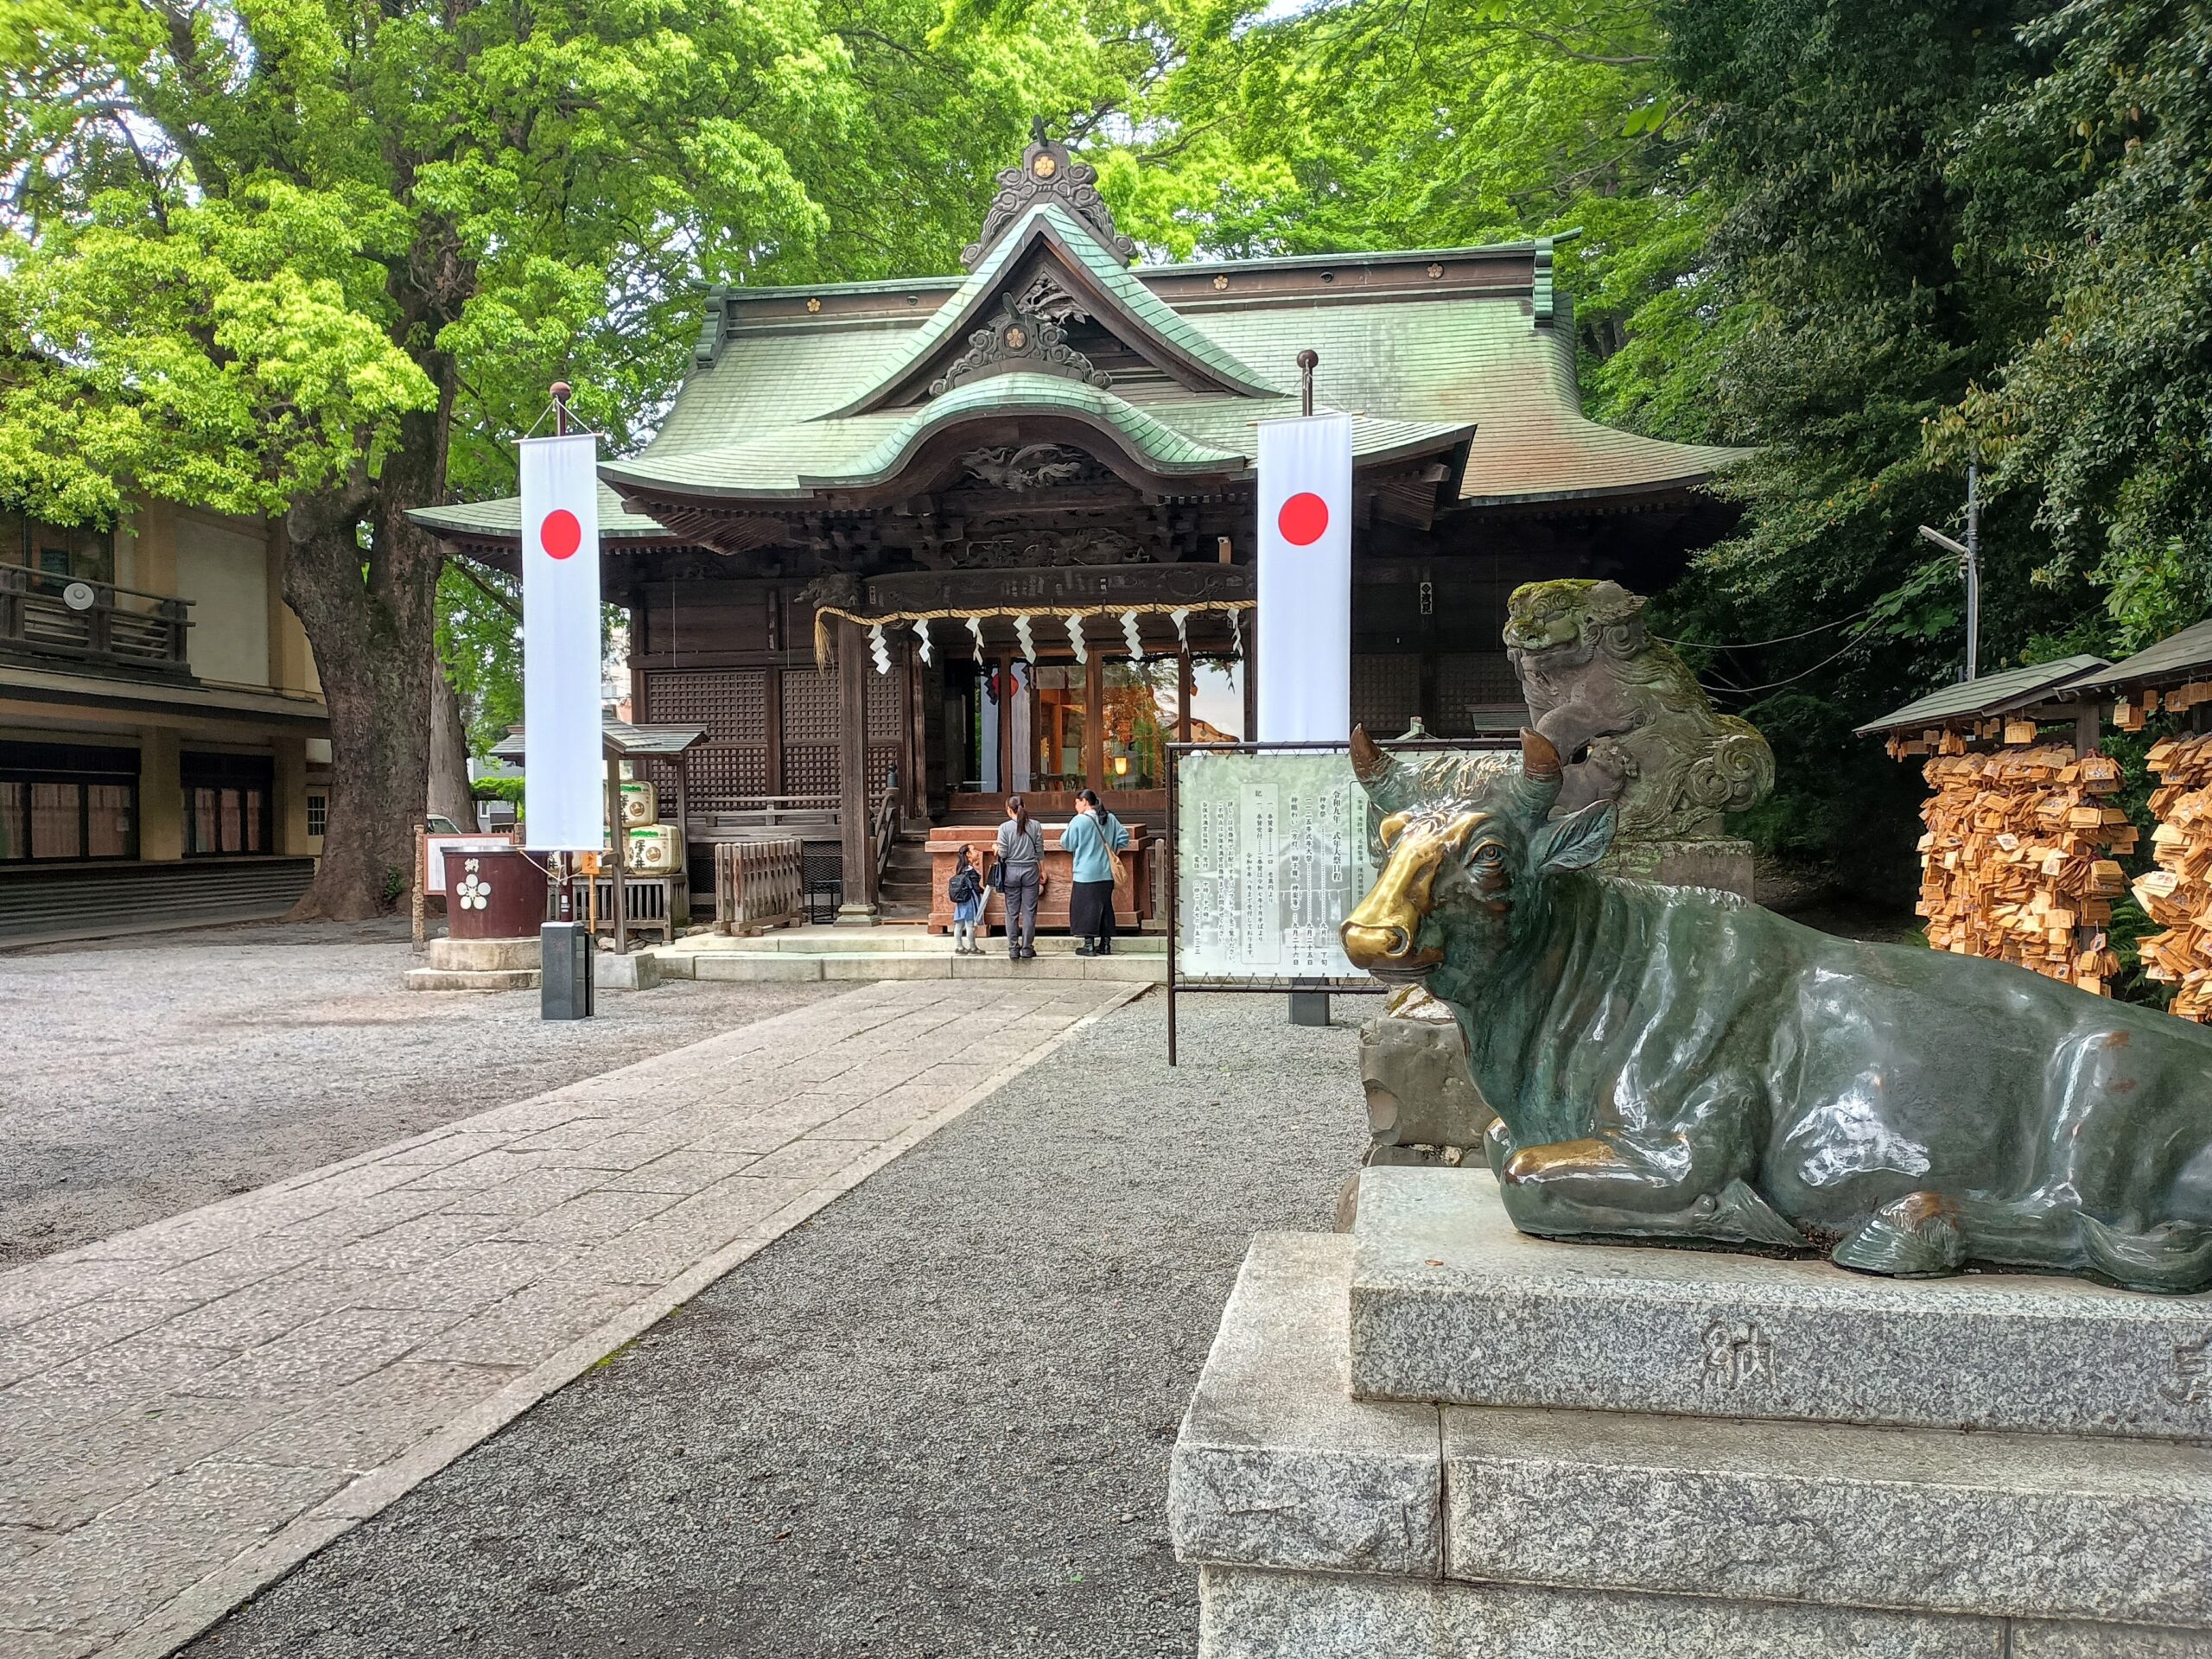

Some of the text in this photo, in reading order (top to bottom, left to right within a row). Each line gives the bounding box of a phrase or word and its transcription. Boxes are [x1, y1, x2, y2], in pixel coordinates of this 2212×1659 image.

[1332, 790, 1342, 881] 令和九年 式年大祭日程
[1306, 923, 1314, 966] 九月二十五日
[1320, 923, 1327, 938] 九月
[1320, 951, 1328, 966] 下旬
